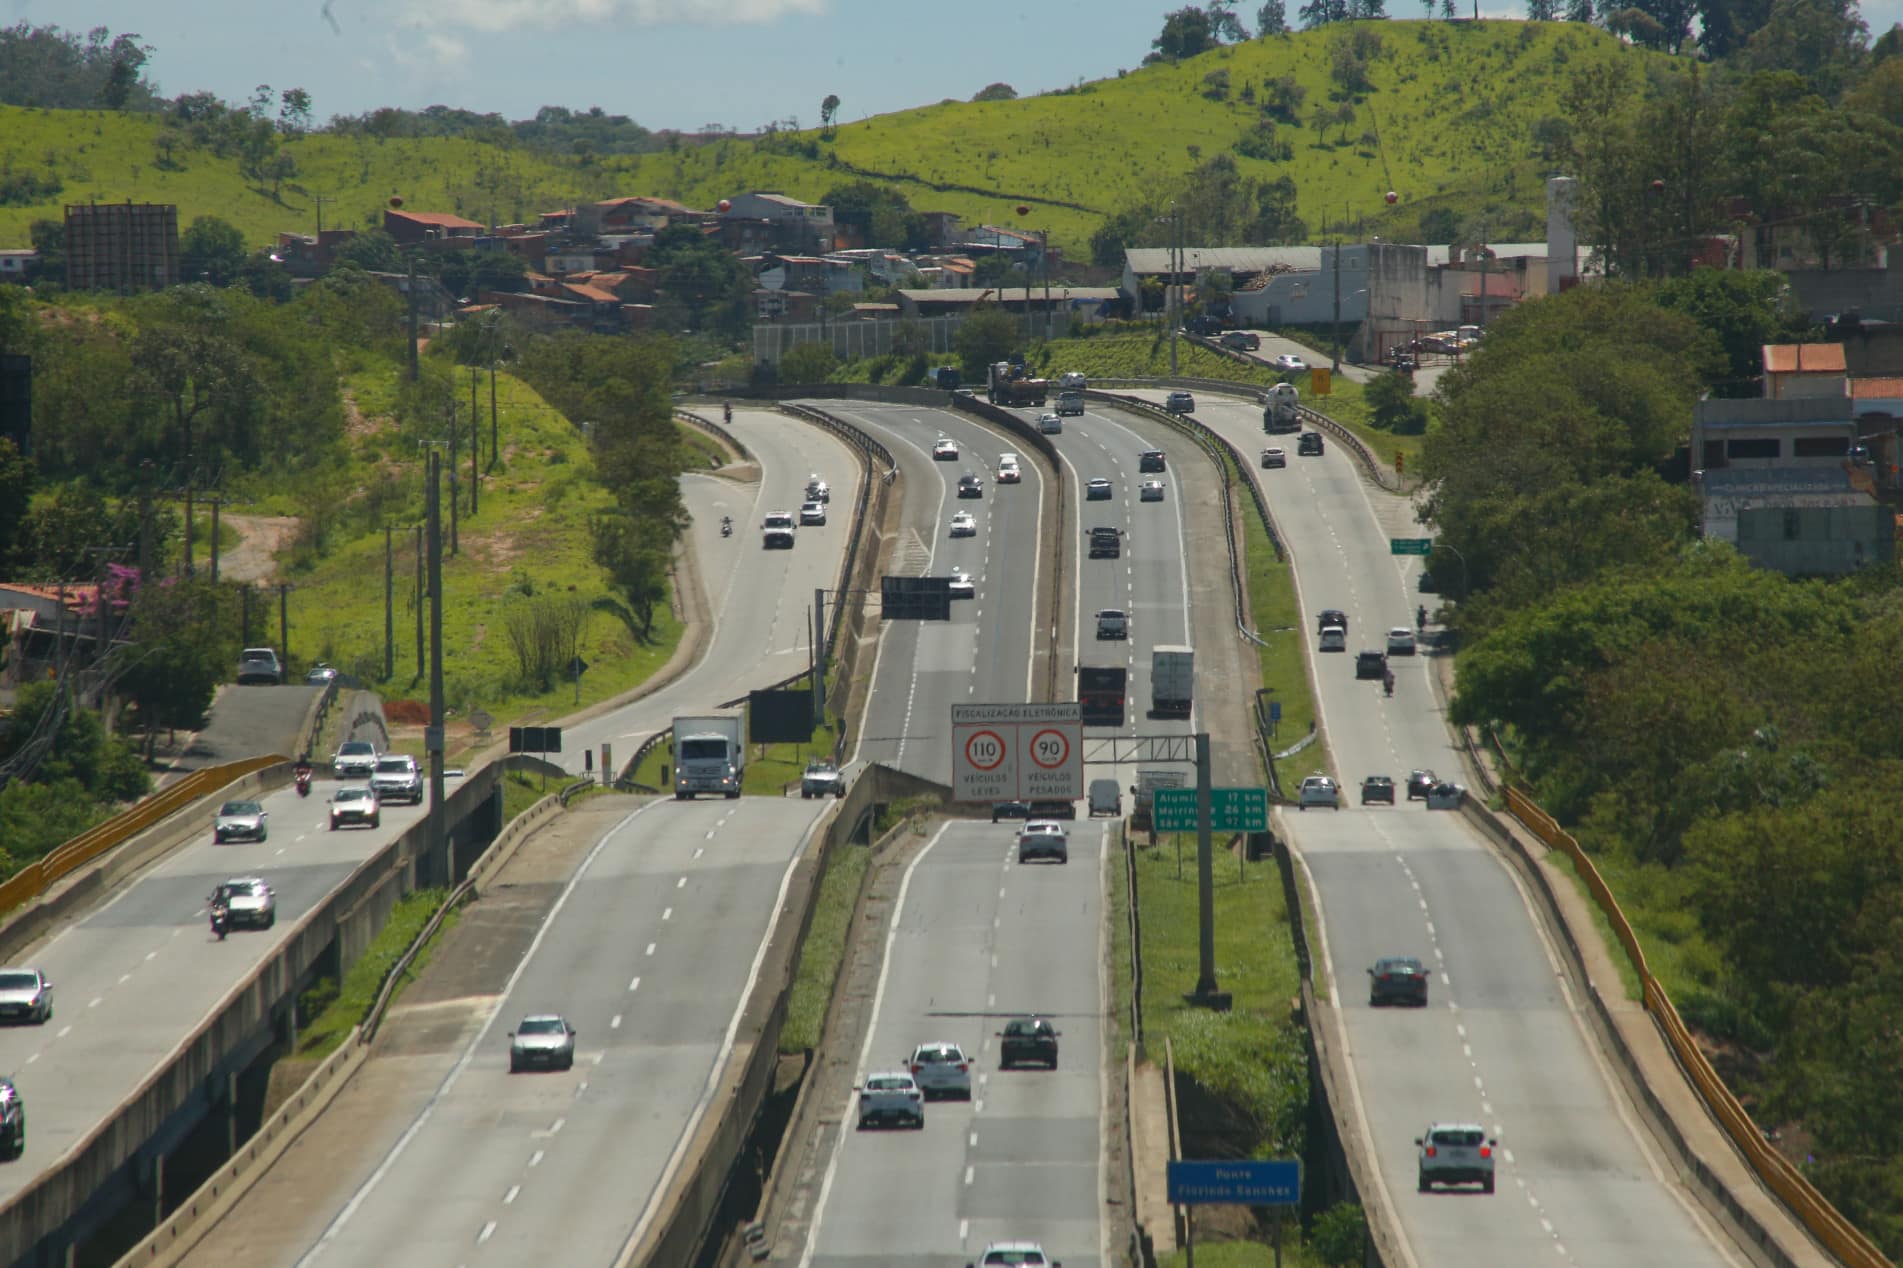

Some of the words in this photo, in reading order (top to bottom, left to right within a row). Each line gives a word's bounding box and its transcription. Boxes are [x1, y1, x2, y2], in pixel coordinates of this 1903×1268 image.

[956, 706, 1020, 719] FISCALIZAÇÃO
[1023, 705, 1078, 718] ELETRÔNICA
[973, 742, 996, 757] 110
[1039, 741, 1060, 756] 90
[964, 773, 1007, 783] VEÍCULOS
[1028, 772, 1072, 782] VEÍCULOS
[971, 786, 1000, 796] LEVES
[1029, 785, 1072, 794] PESADOS
[1228, 792, 1239, 802] 17
[1245, 792, 1262, 802] km
[1158, 805, 1217, 816] Mairine
[1245, 805, 1262, 815] km
[1245, 818, 1262, 828] km
[1215, 1167, 1252, 1180] Ponte
[1177, 1184, 1231, 1197] Florindo
